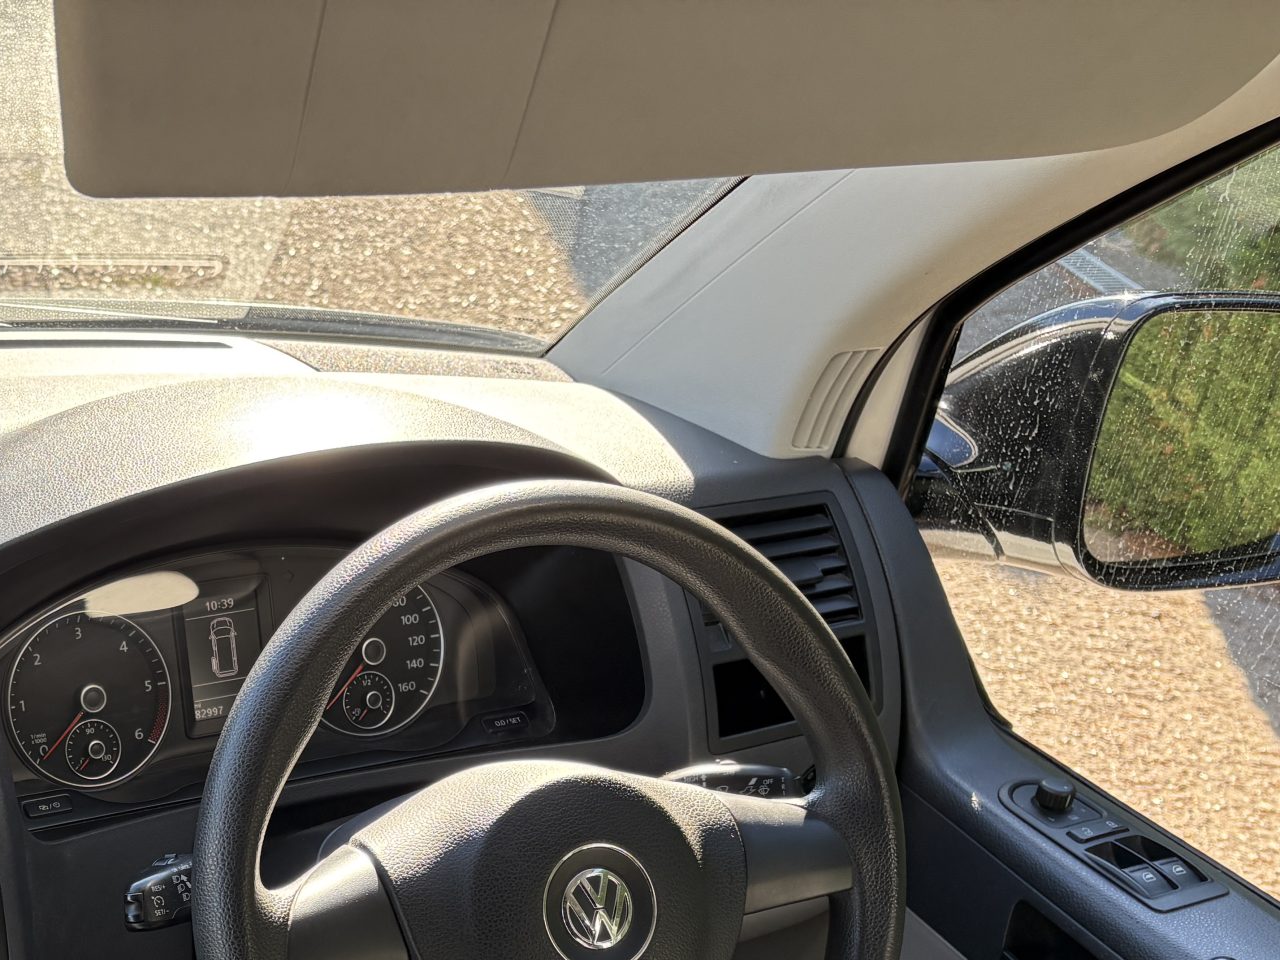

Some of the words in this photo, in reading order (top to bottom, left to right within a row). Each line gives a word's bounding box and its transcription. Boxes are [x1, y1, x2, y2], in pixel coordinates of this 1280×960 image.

[205, 598, 234, 611] 10:39
[401, 613, 419, 625] 100
[75, 627, 82, 639] 3
[120, 641, 128, 652] 4
[408, 635, 425, 646] 120
[33, 653, 42, 665] 2
[406, 658, 424, 670] 140
[144, 680, 152, 692] 5
[398, 681, 416, 692] 160
[19, 700, 26, 712] 1
[195, 706, 224, 720] 82997
[135, 728, 144, 740] 6
[40, 745, 49, 757] 0
